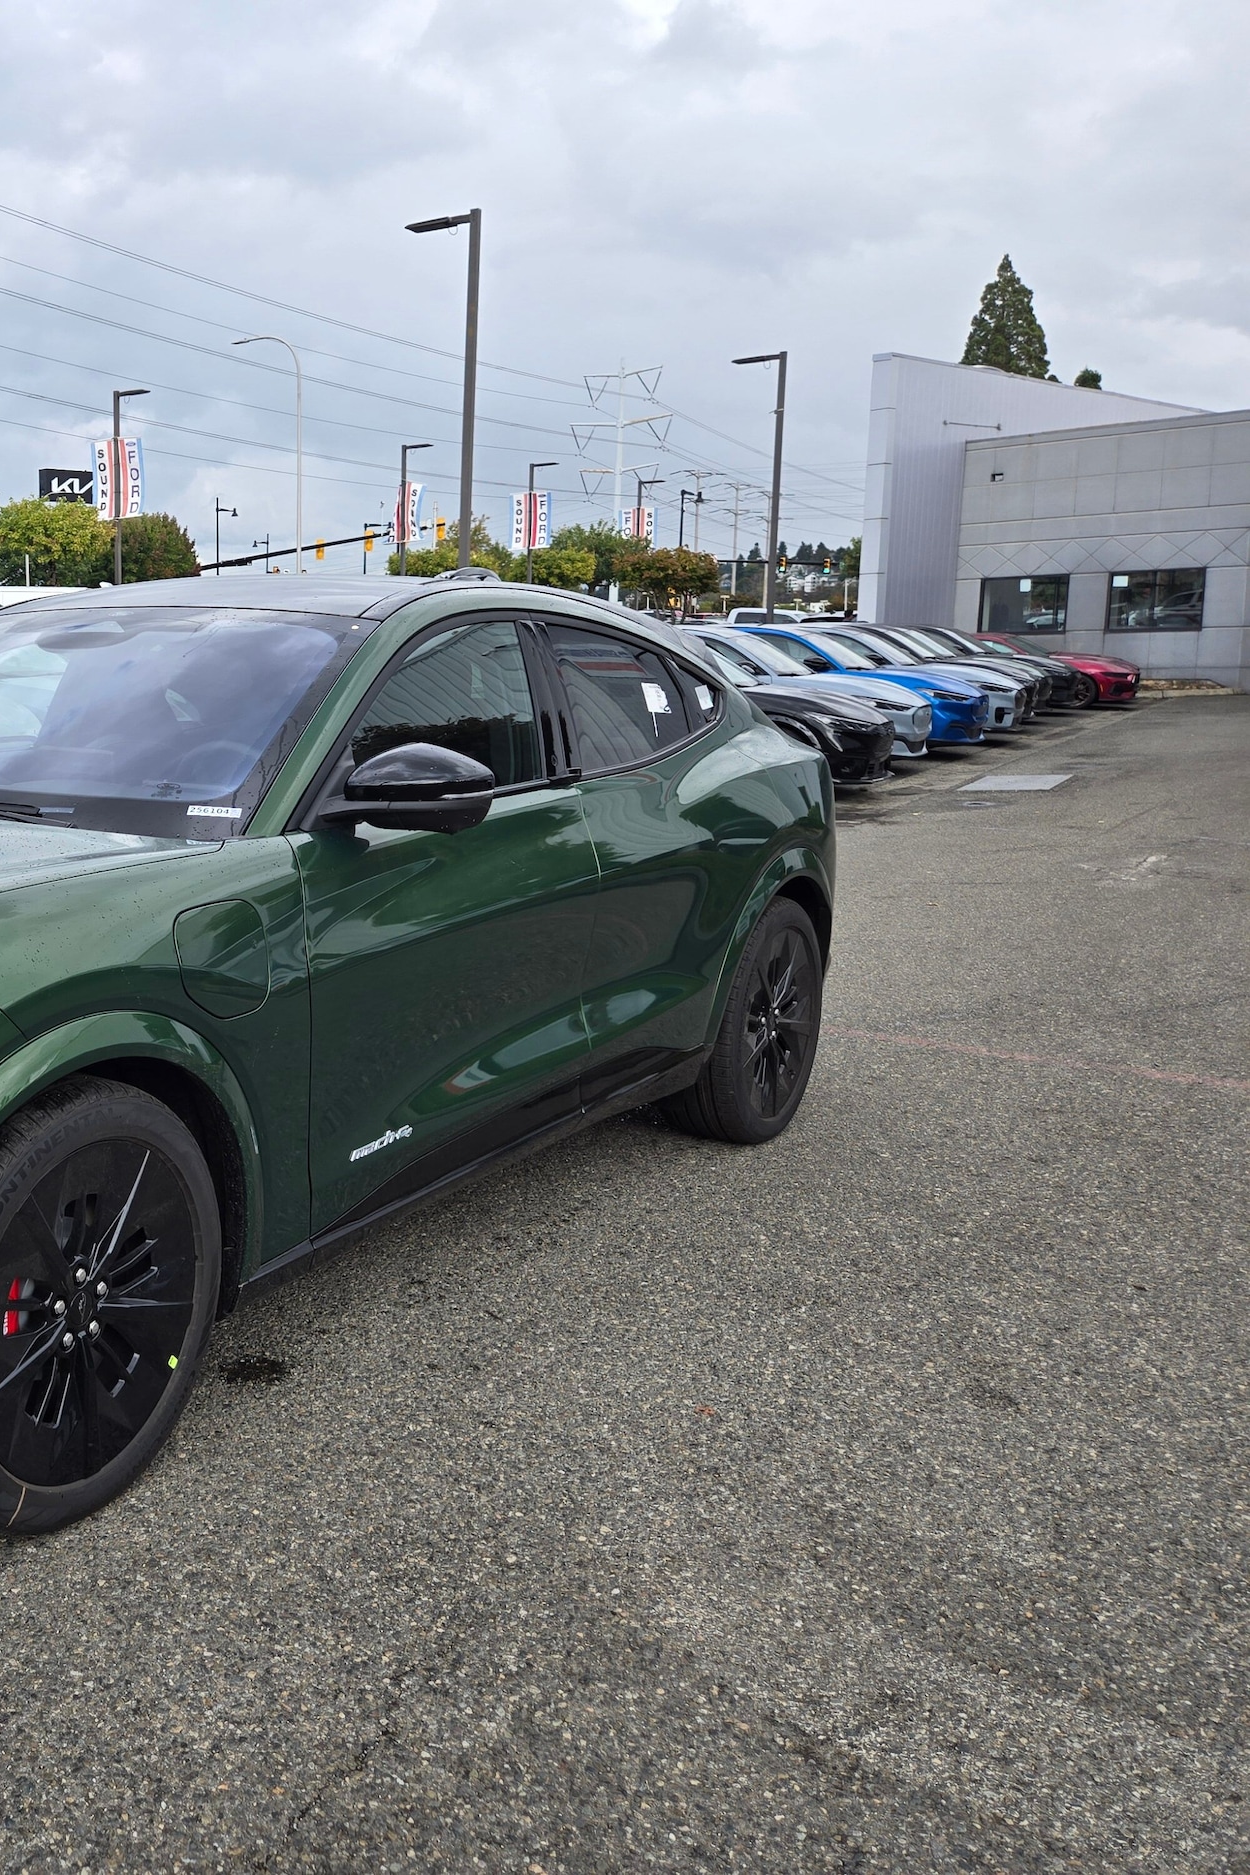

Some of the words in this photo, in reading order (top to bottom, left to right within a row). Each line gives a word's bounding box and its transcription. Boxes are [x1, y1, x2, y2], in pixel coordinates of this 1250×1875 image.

[97, 449, 108, 511] SOUND
[127, 450, 140, 514] FORD
[515, 500, 523, 544] SOUND
[538, 500, 547, 545] FORD
[189, 806, 230, 815] 256104
